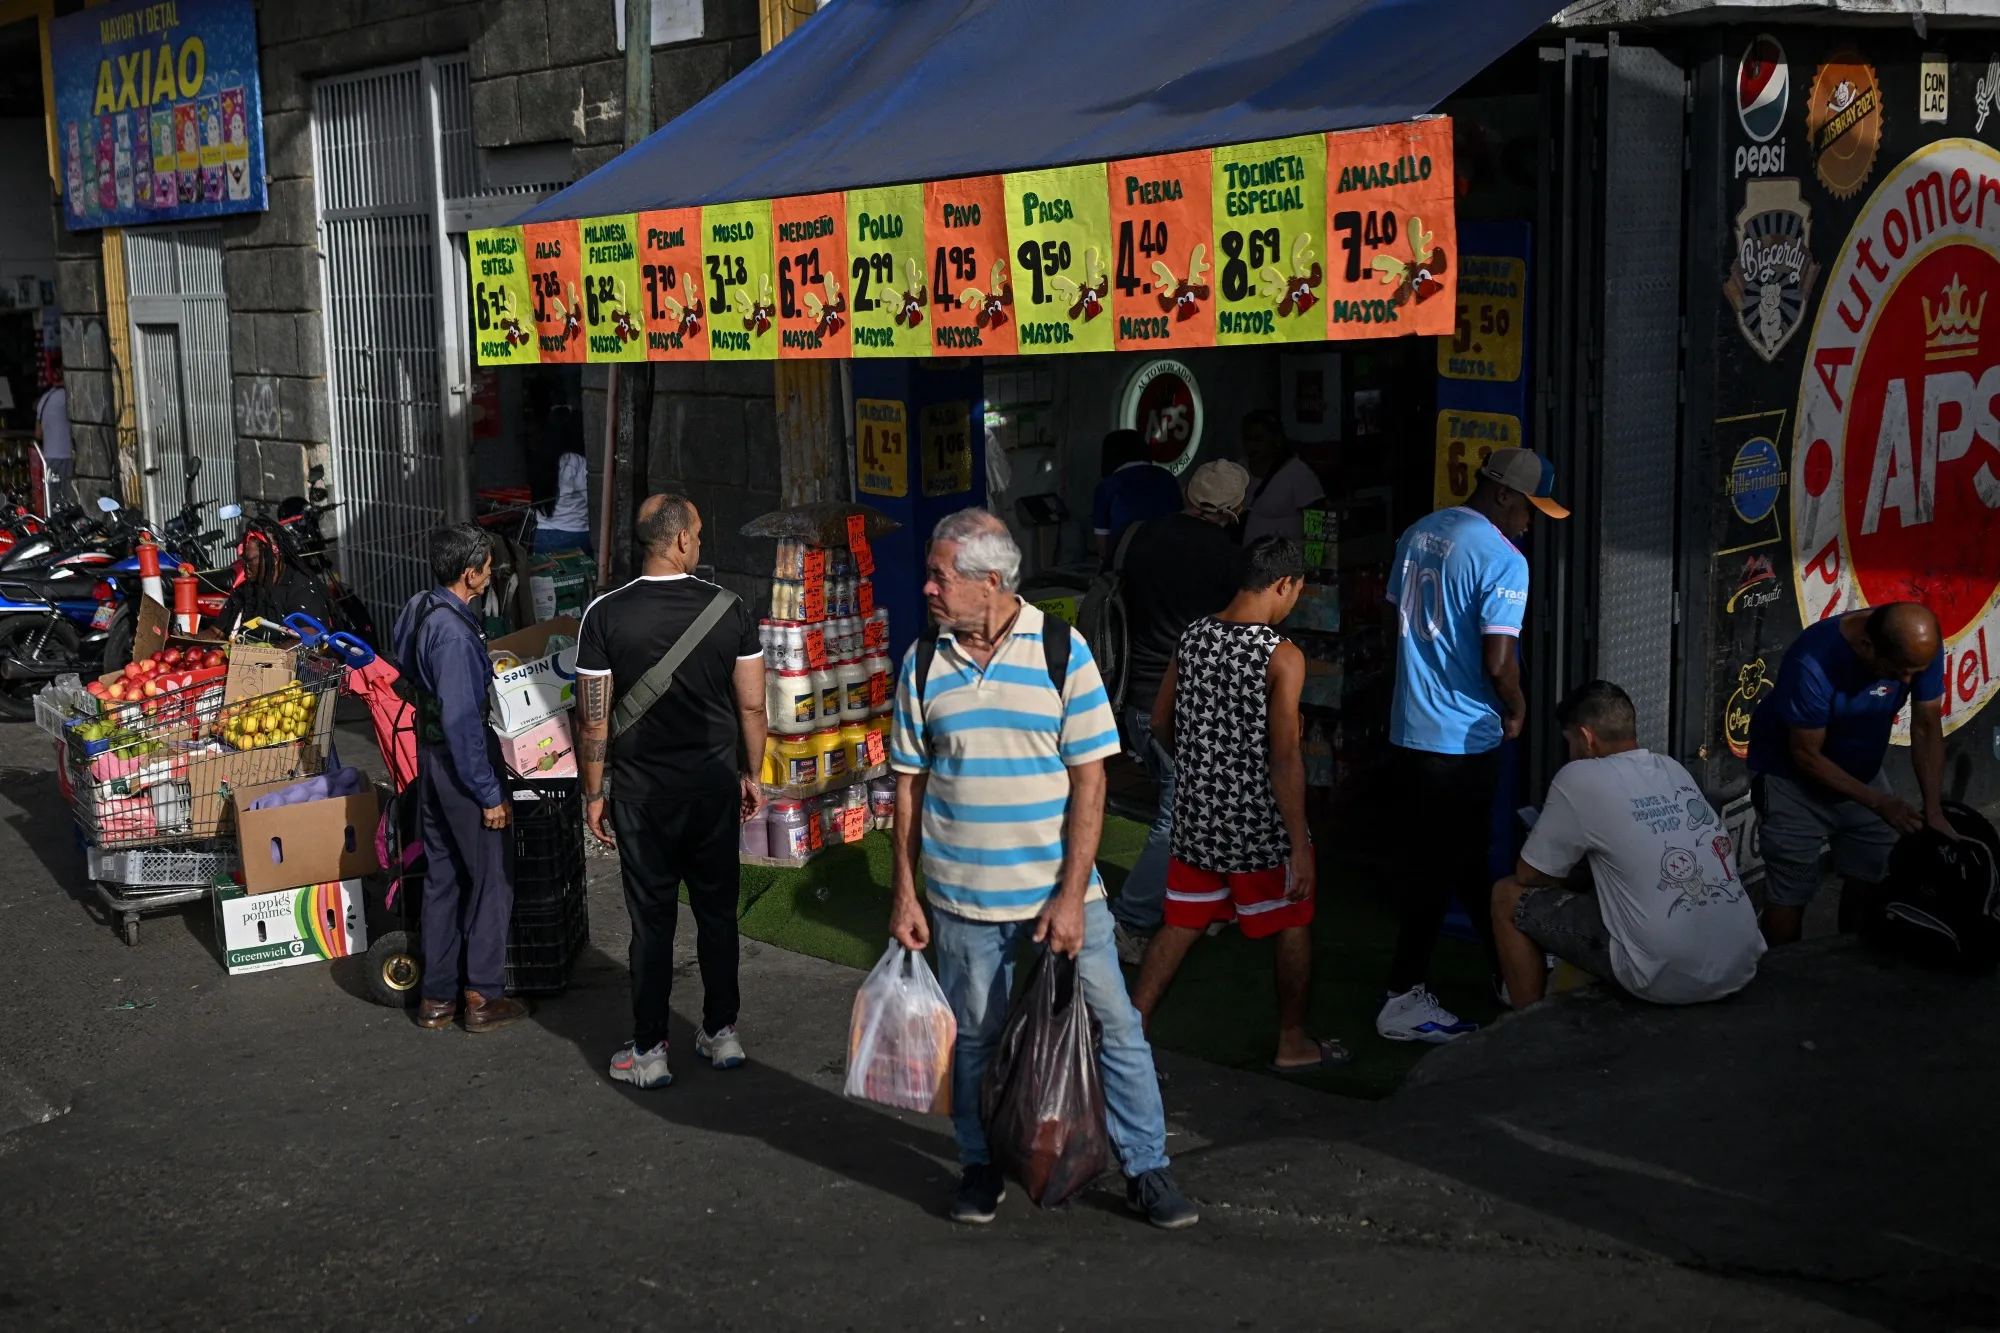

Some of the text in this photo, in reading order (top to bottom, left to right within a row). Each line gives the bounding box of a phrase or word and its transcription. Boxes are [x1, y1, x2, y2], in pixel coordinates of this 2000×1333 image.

[101, 2, 180, 45] MAYOR Y DETAL
[94, 31, 205, 116] AXIÁO
[1924, 71, 1946, 92] CON
[1856, 89, 1877, 118] 2021
[1924, 93, 1946, 113] LAC
[1735, 137, 1786, 179] pepsi
[1224, 155, 1305, 190] TOCINETA
[1336, 155, 1432, 193] AMARILLO
[1125, 175, 1183, 206] PIERNA
[1226, 186, 1304, 217] ESPECIAL
[943, 203, 981, 228] PAVO
[1022, 192, 1074, 226] PAISA
[584, 224, 627, 245] MILANESA
[713, 220, 754, 243] MUSLO
[779, 214, 834, 243] MERIDEÑO
[858, 212, 903, 242] POLLO
[476, 238, 518, 256] MILANESA
[535, 240, 561, 259] ALAS
[648, 227, 685, 251] PERNIL
[589, 242, 635, 264] FILETEADA
[481, 258, 515, 276] ENTERA
[1220, 309, 1276, 335] MAYOR
[1333, 298, 1398, 324] MAYOR
[855, 326, 895, 347] MAYOR
[937, 326, 983, 349] MAYOR
[1021, 322, 1074, 344] MAYOR
[1119, 315, 1170, 340] MAYOR
[481, 341, 512, 357] MAYOR
[590, 335, 622, 353] MAYOR
[648, 331, 684, 350] MAYOR
[711, 329, 751, 351] MAYOR
[783, 329, 823, 350] MAYOR
[1144, 404, 1190, 446] APS
[1724, 471, 1788, 496] Millennium
[1410, 530, 1456, 559] MESSI
[1400, 559, 1444, 642] 10
[503, 660, 550, 684] Niches
[1631, 794, 1671, 809] TAKE A
[1632, 803, 1684, 822] ROMANTIC
[1647, 815, 1681, 835] TRIP
[251, 893, 291, 911] apples
[242, 907, 292, 926] pommes
[231, 946, 287, 963] Greenwich
